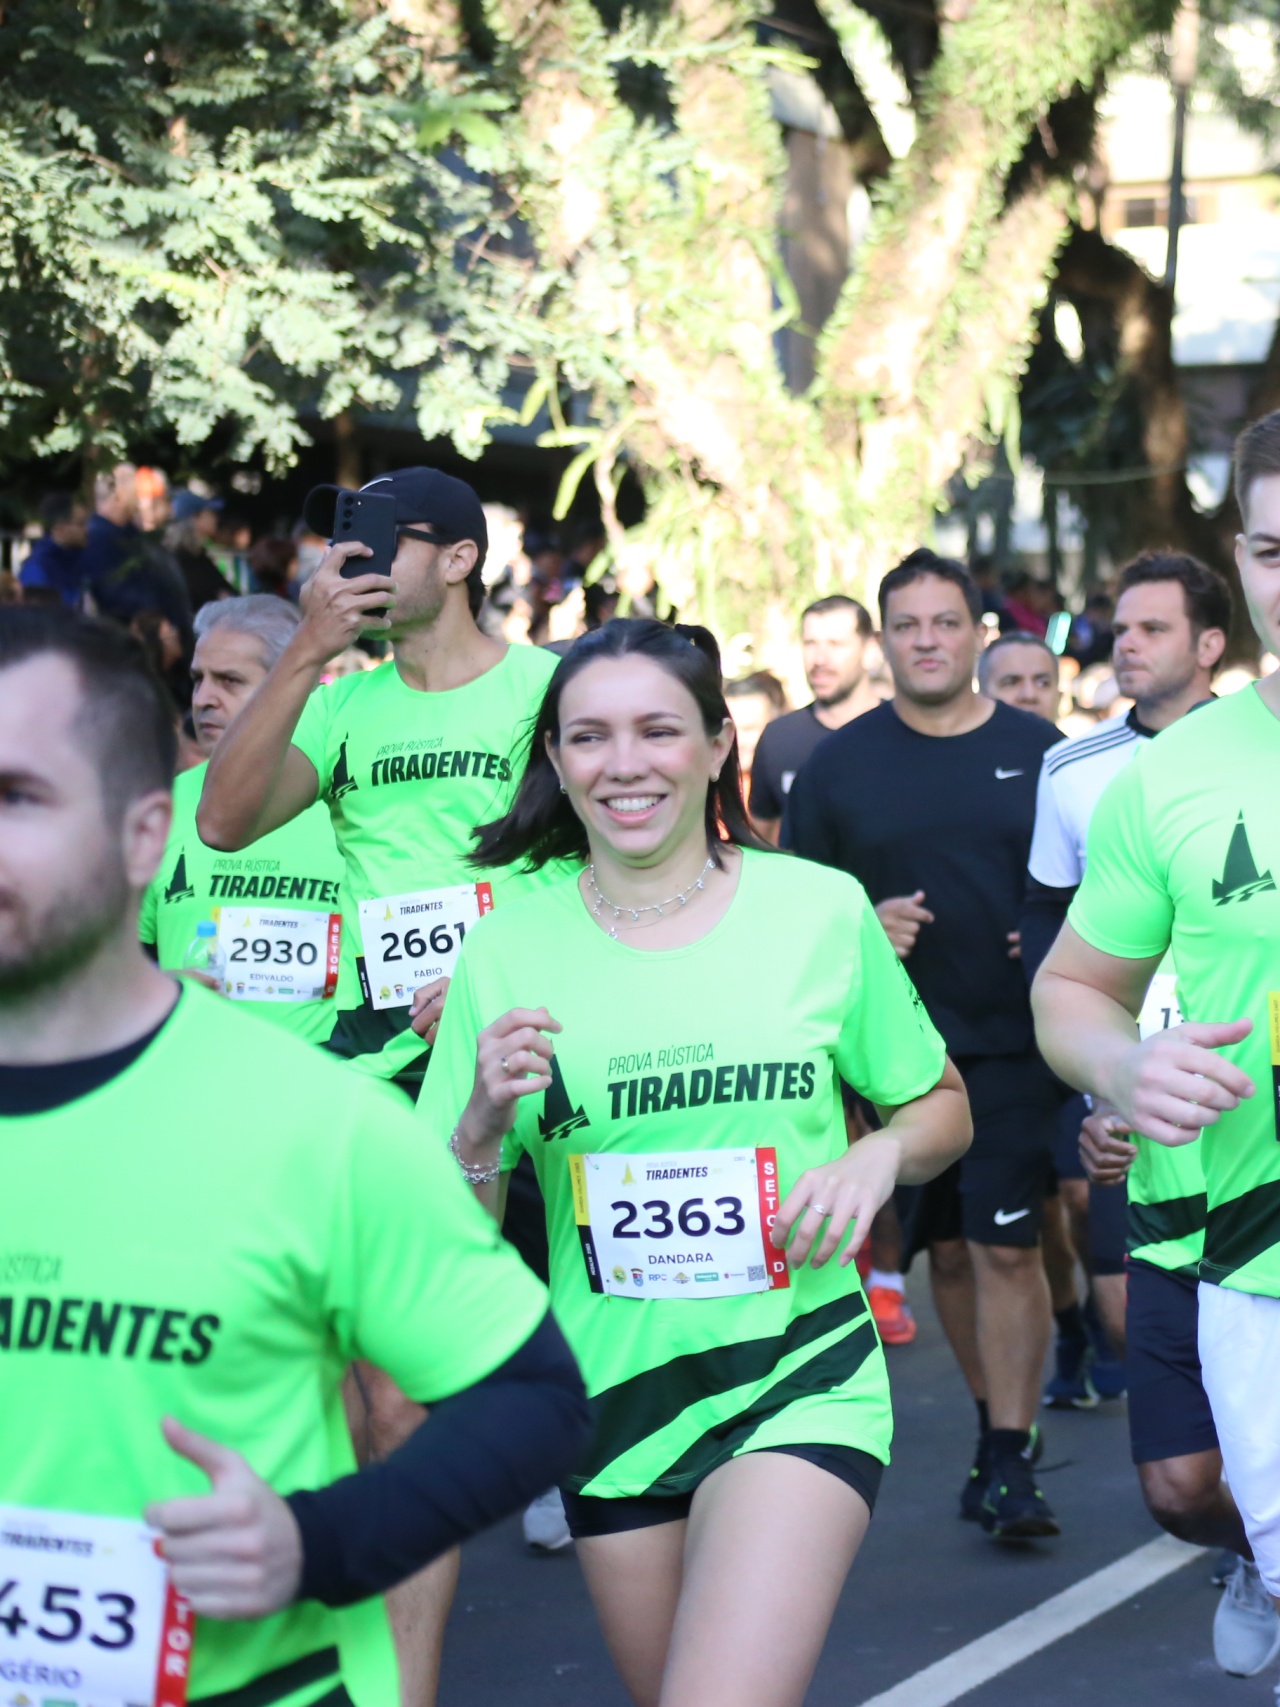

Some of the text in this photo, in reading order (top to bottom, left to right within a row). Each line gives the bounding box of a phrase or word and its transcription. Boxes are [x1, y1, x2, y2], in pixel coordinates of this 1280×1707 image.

[376, 742, 404, 758] PROVA
[371, 750, 512, 786] TIRADENTES
[213, 858, 280, 873] PROVA RÚSTICA
[400, 901, 443, 916] TIRADENTES
[259, 918, 298, 928] TIRADENTES
[229, 937, 318, 966] 2930
[331, 923, 339, 975] SETOR
[380, 921, 466, 963] 2661
[250, 973, 293, 982] EDIVALDO
[414, 967, 443, 978] FABIO
[607, 1042, 714, 1076] PROVA RÚSTICA
[607, 1061, 815, 1120] TIRADENTES
[646, 1166, 708, 1181] TIRADENTES
[610, 1196, 746, 1239] 2363
[764, 1162, 786, 1273] SETO D
[648, 1253, 714, 1265] DANDARA
